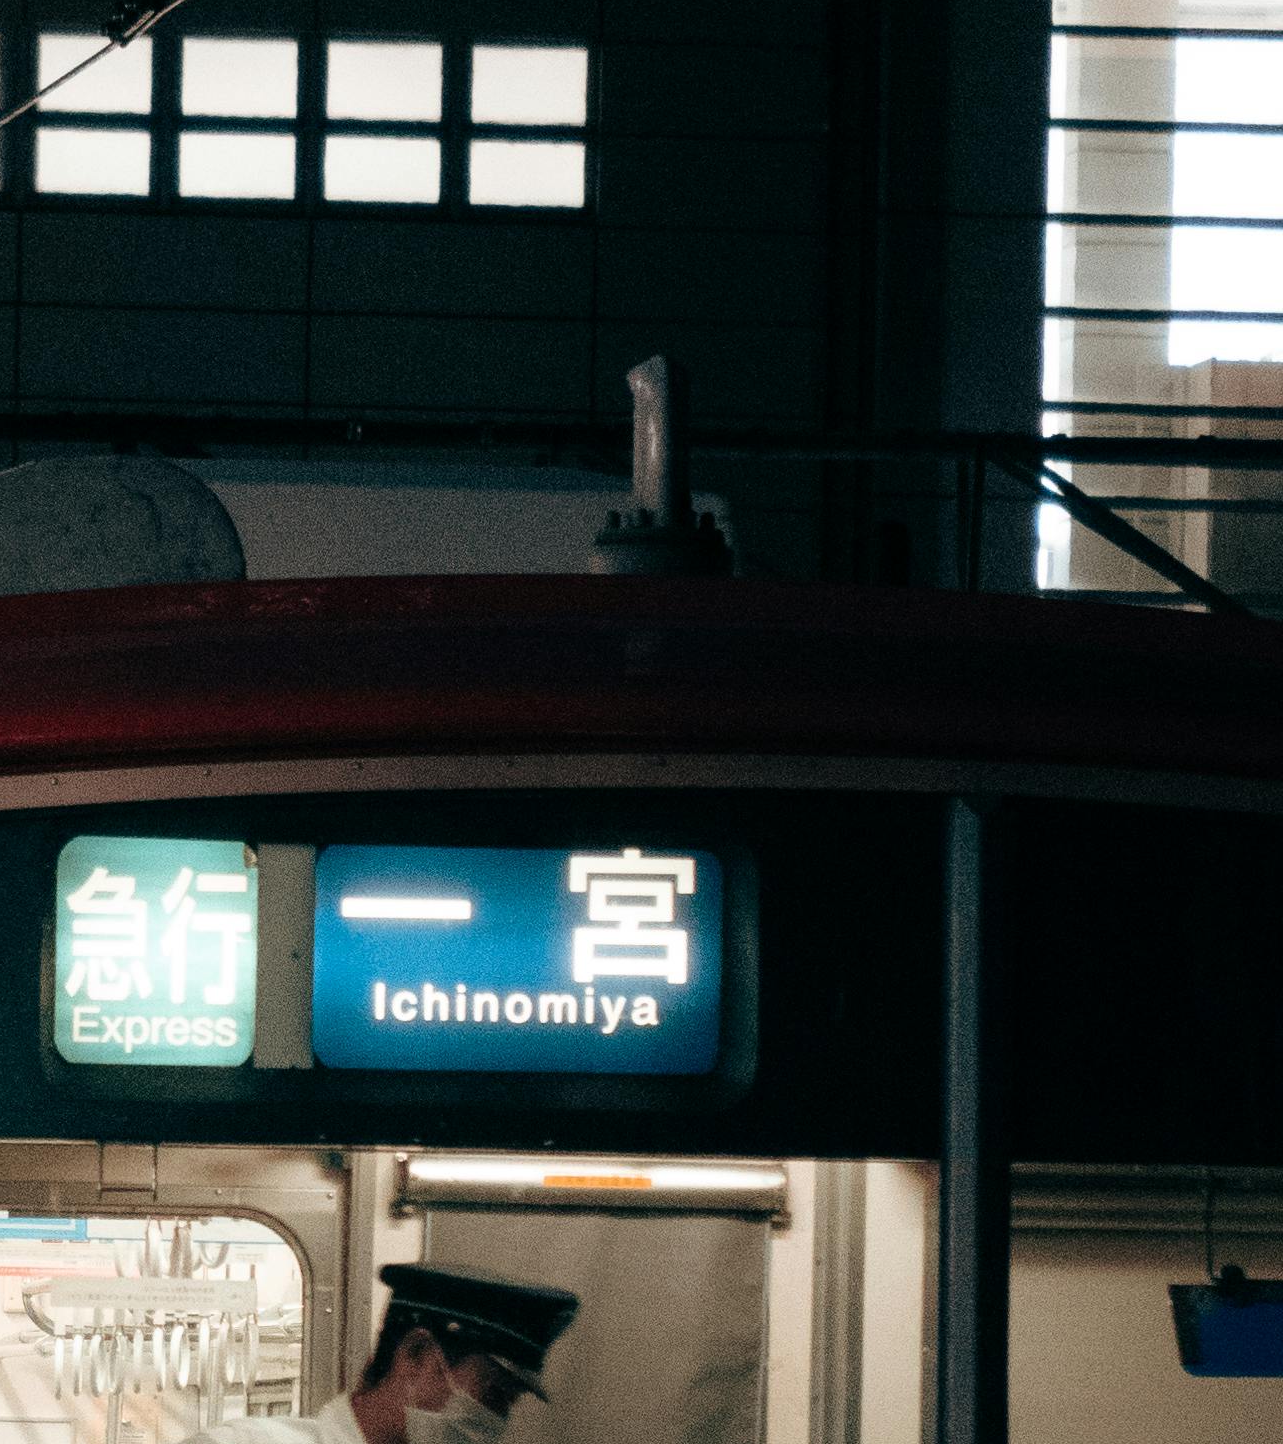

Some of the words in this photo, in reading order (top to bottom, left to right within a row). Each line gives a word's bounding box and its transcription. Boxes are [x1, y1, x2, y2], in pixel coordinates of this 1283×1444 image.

[65, 865, 251, 1005] 急行
[340, 848, 696, 985] 一宮
[70, 1005, 238, 1054] Express
[372, 981, 660, 1035] Ichinomiya
